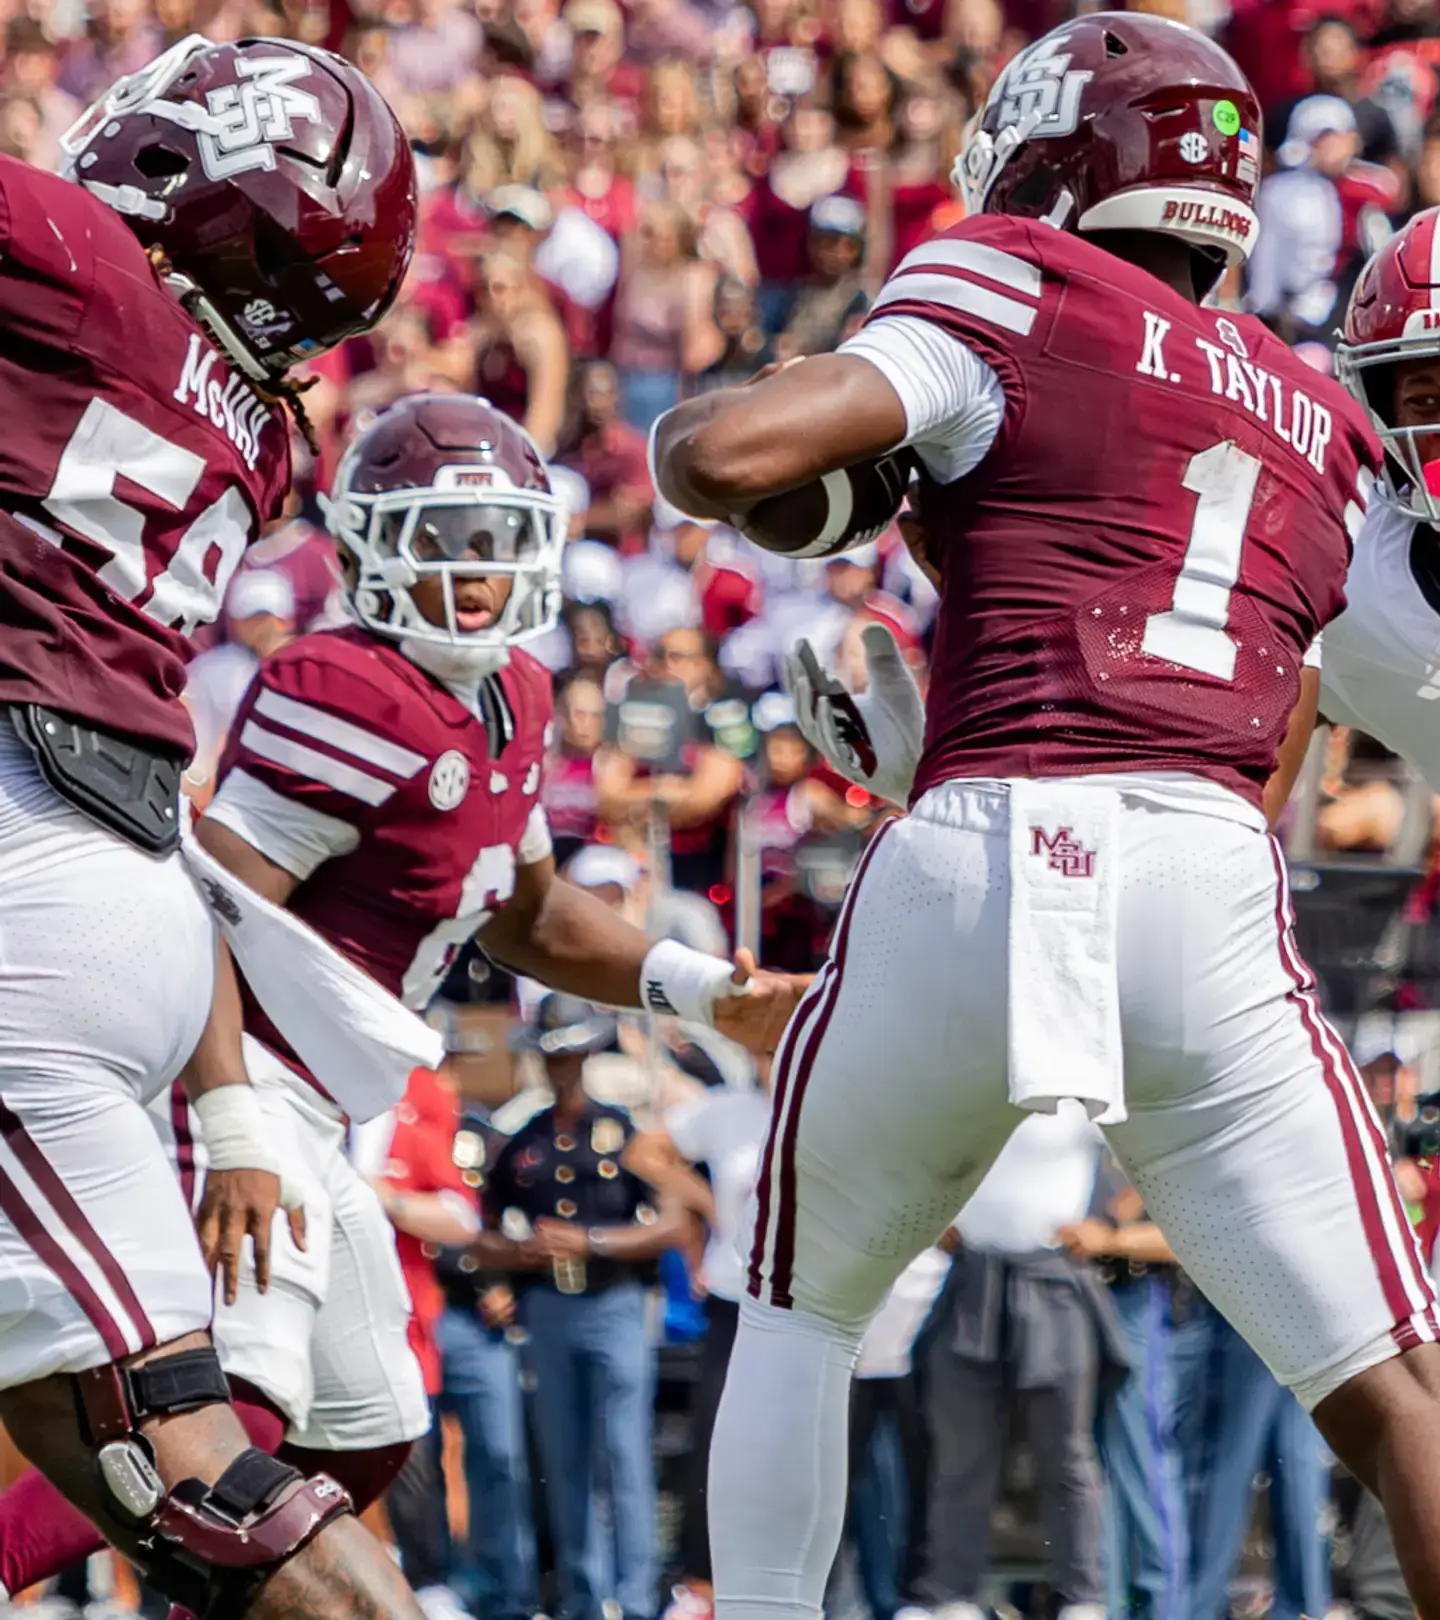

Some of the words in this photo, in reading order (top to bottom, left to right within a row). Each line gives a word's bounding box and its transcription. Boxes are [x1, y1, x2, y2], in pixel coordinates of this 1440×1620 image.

[196, 55, 322, 182] MSU
[1136, 311, 1181, 383] K.
[1195, 338, 1332, 475] TAYLOR
[1140, 440, 1262, 681] 1
[1028, 825, 1097, 878] MSU
